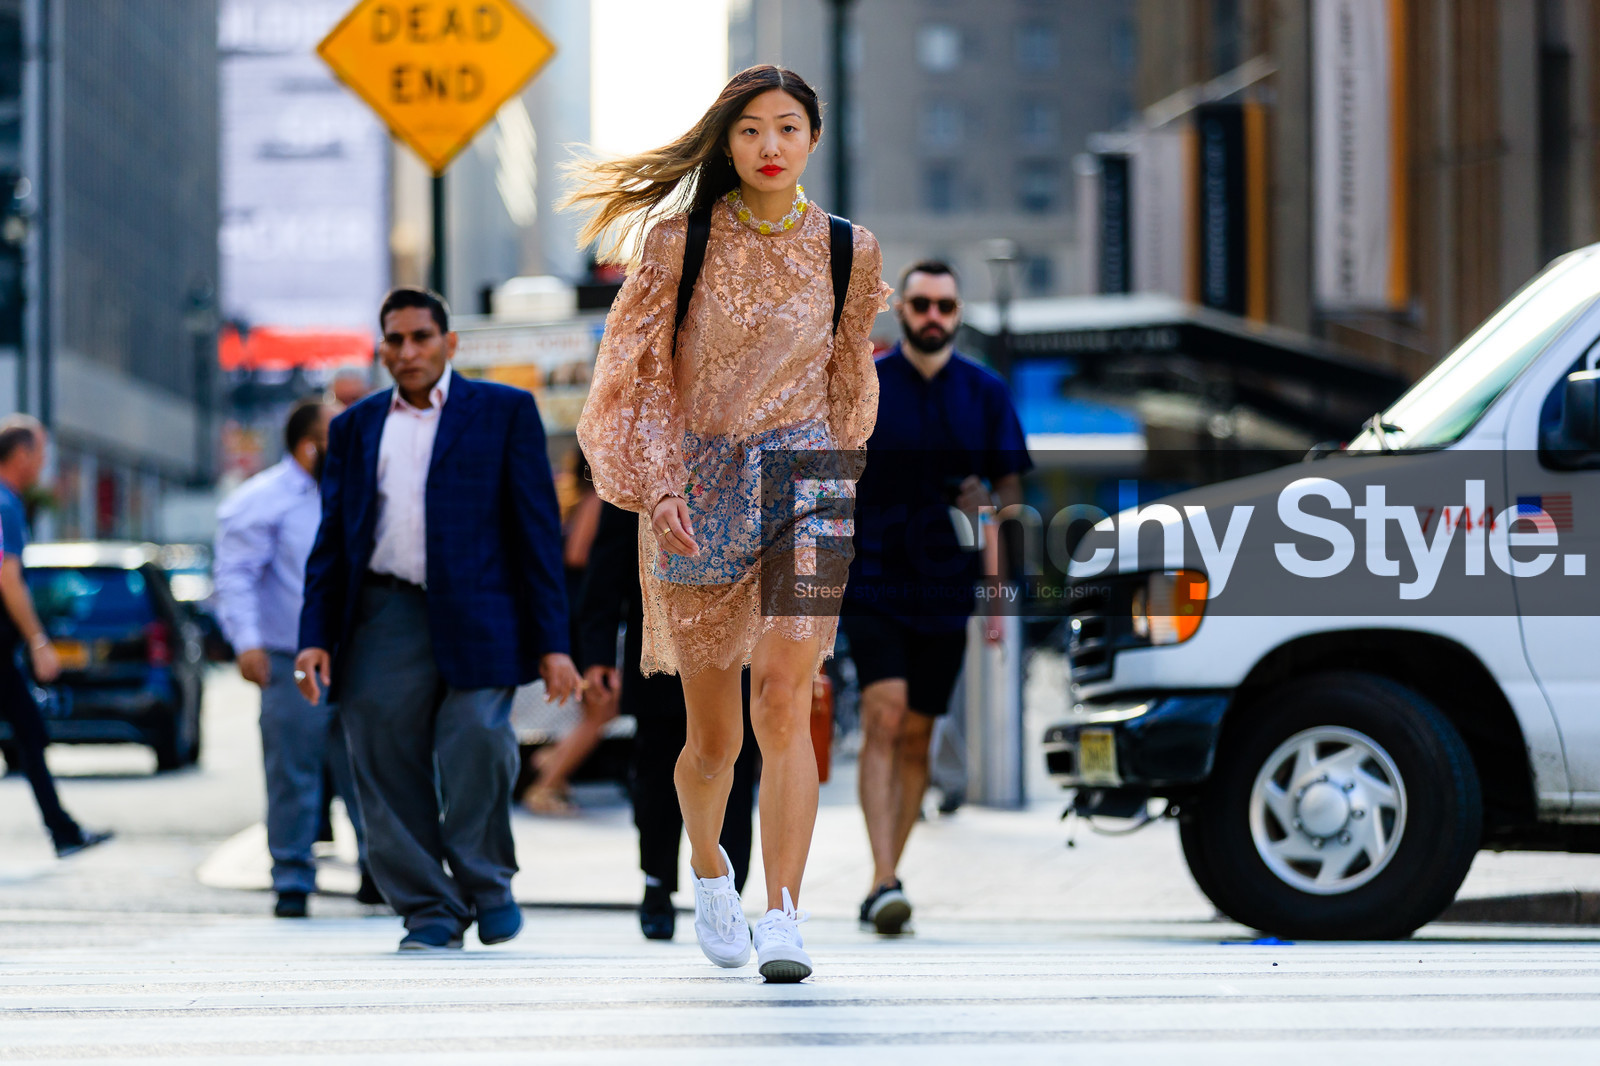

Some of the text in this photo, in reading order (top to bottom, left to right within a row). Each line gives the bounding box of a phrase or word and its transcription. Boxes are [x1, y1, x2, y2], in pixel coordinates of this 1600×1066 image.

[369, 4, 502, 44] DEAD
[389, 63, 486, 104] END
[1417, 504, 1498, 535] 7144
